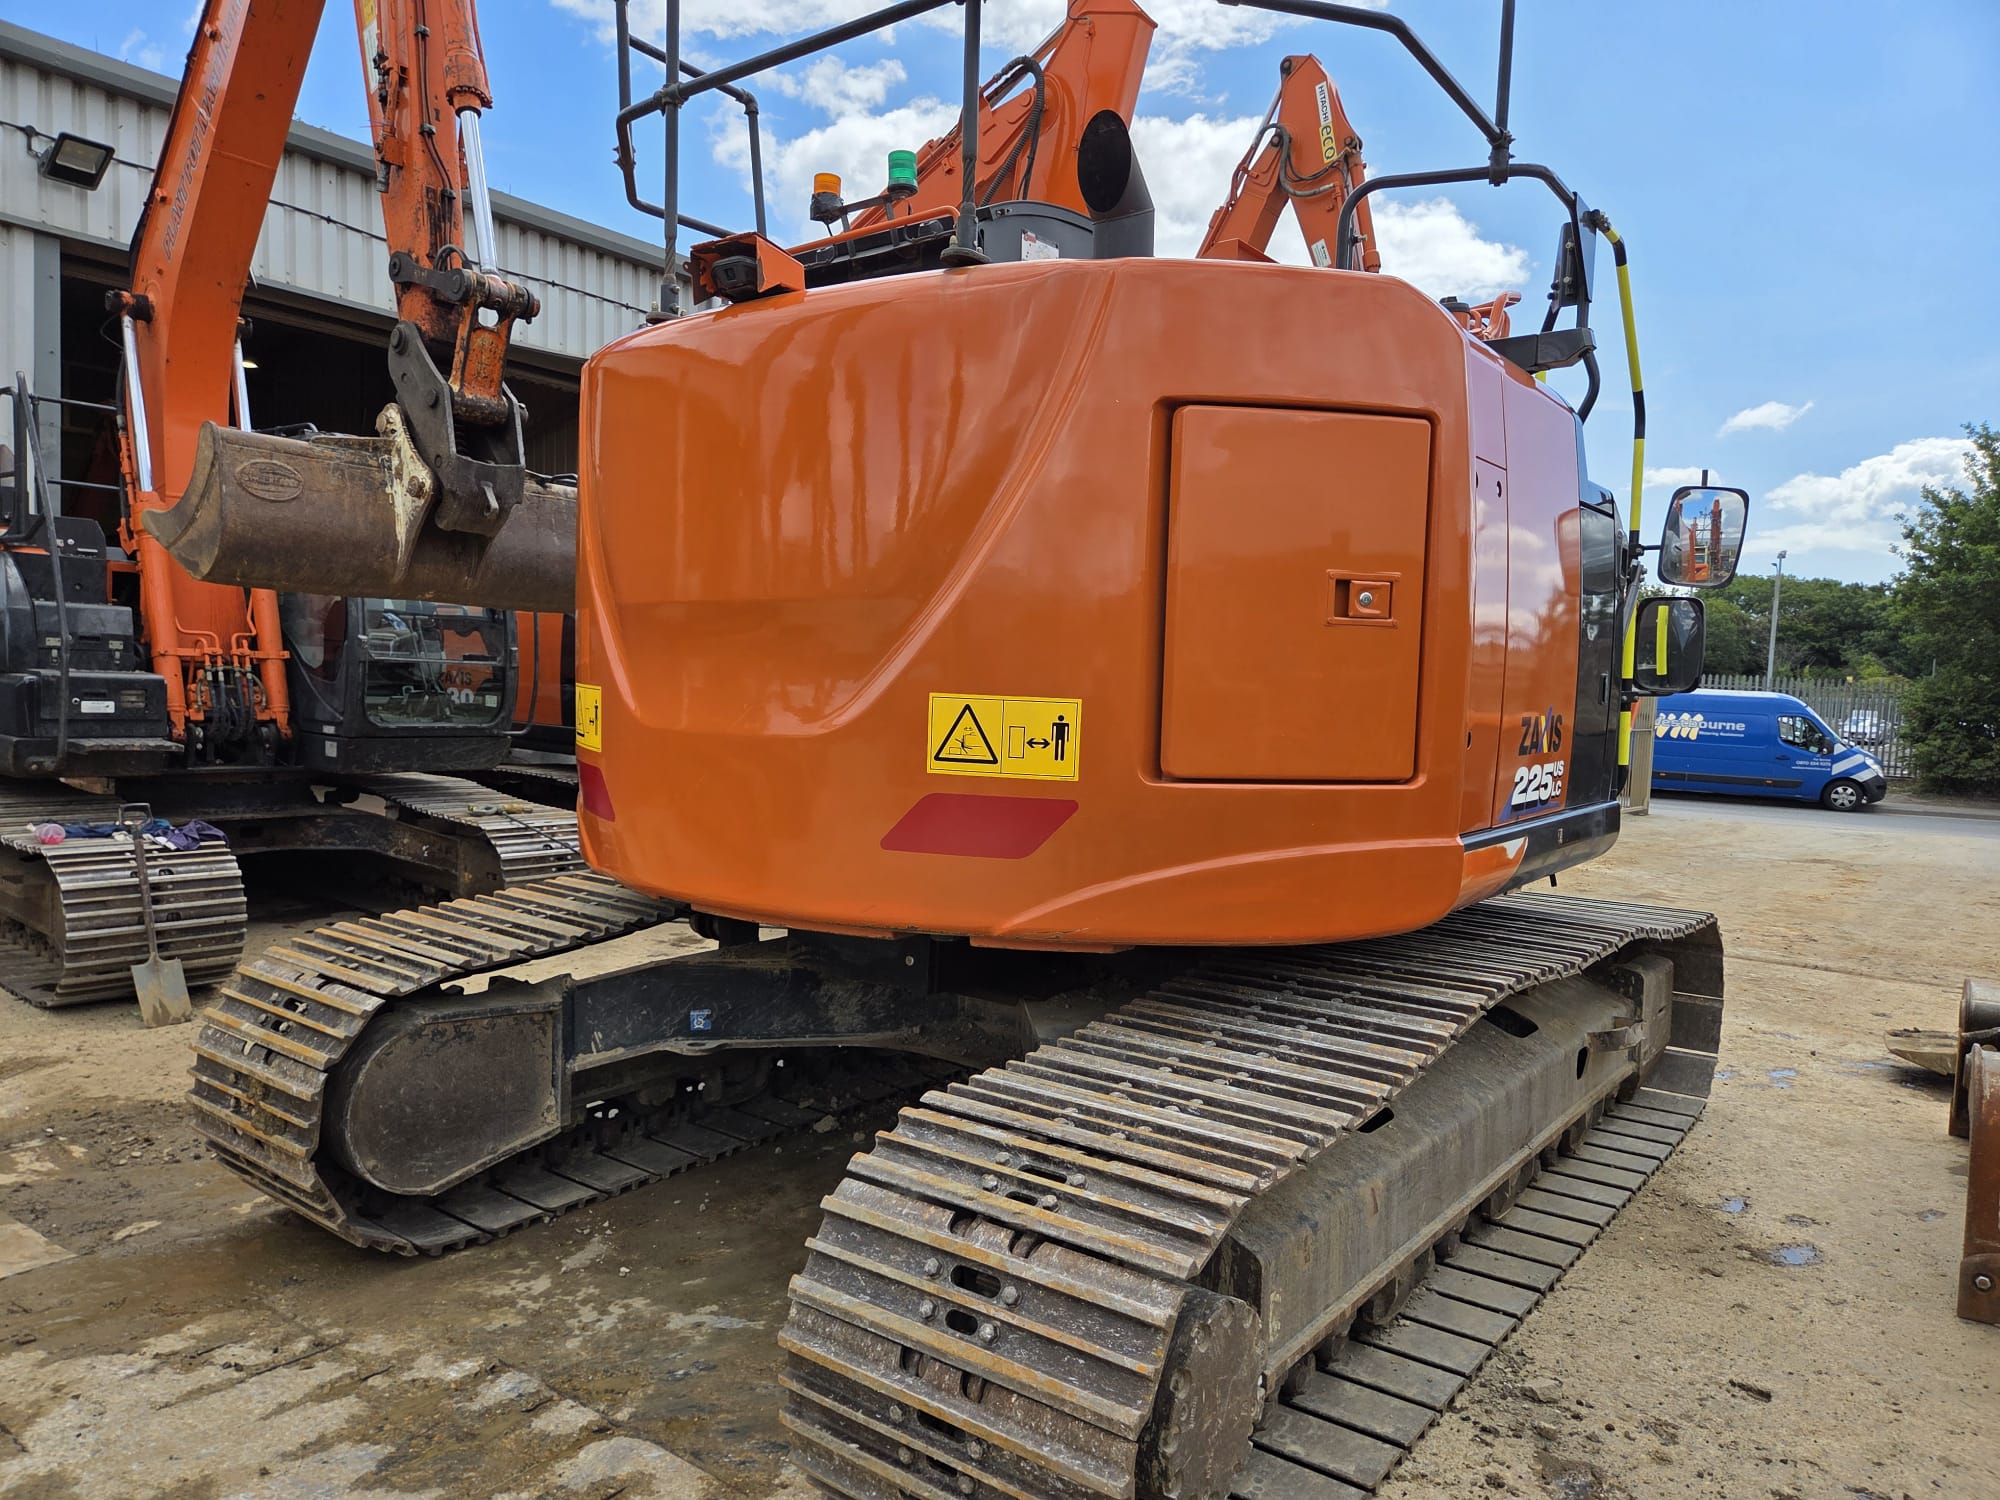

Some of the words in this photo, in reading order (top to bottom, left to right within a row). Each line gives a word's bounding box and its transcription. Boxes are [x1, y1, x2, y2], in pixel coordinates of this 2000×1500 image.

[1318, 86, 1329, 122] HITACHI
[1321, 125, 1336, 160] eco
[1518, 706, 1563, 756] ZAXIS
[1511, 764, 1554, 806] 225
[1553, 760, 1565, 778] US
[1551, 780, 1562, 798] LC
